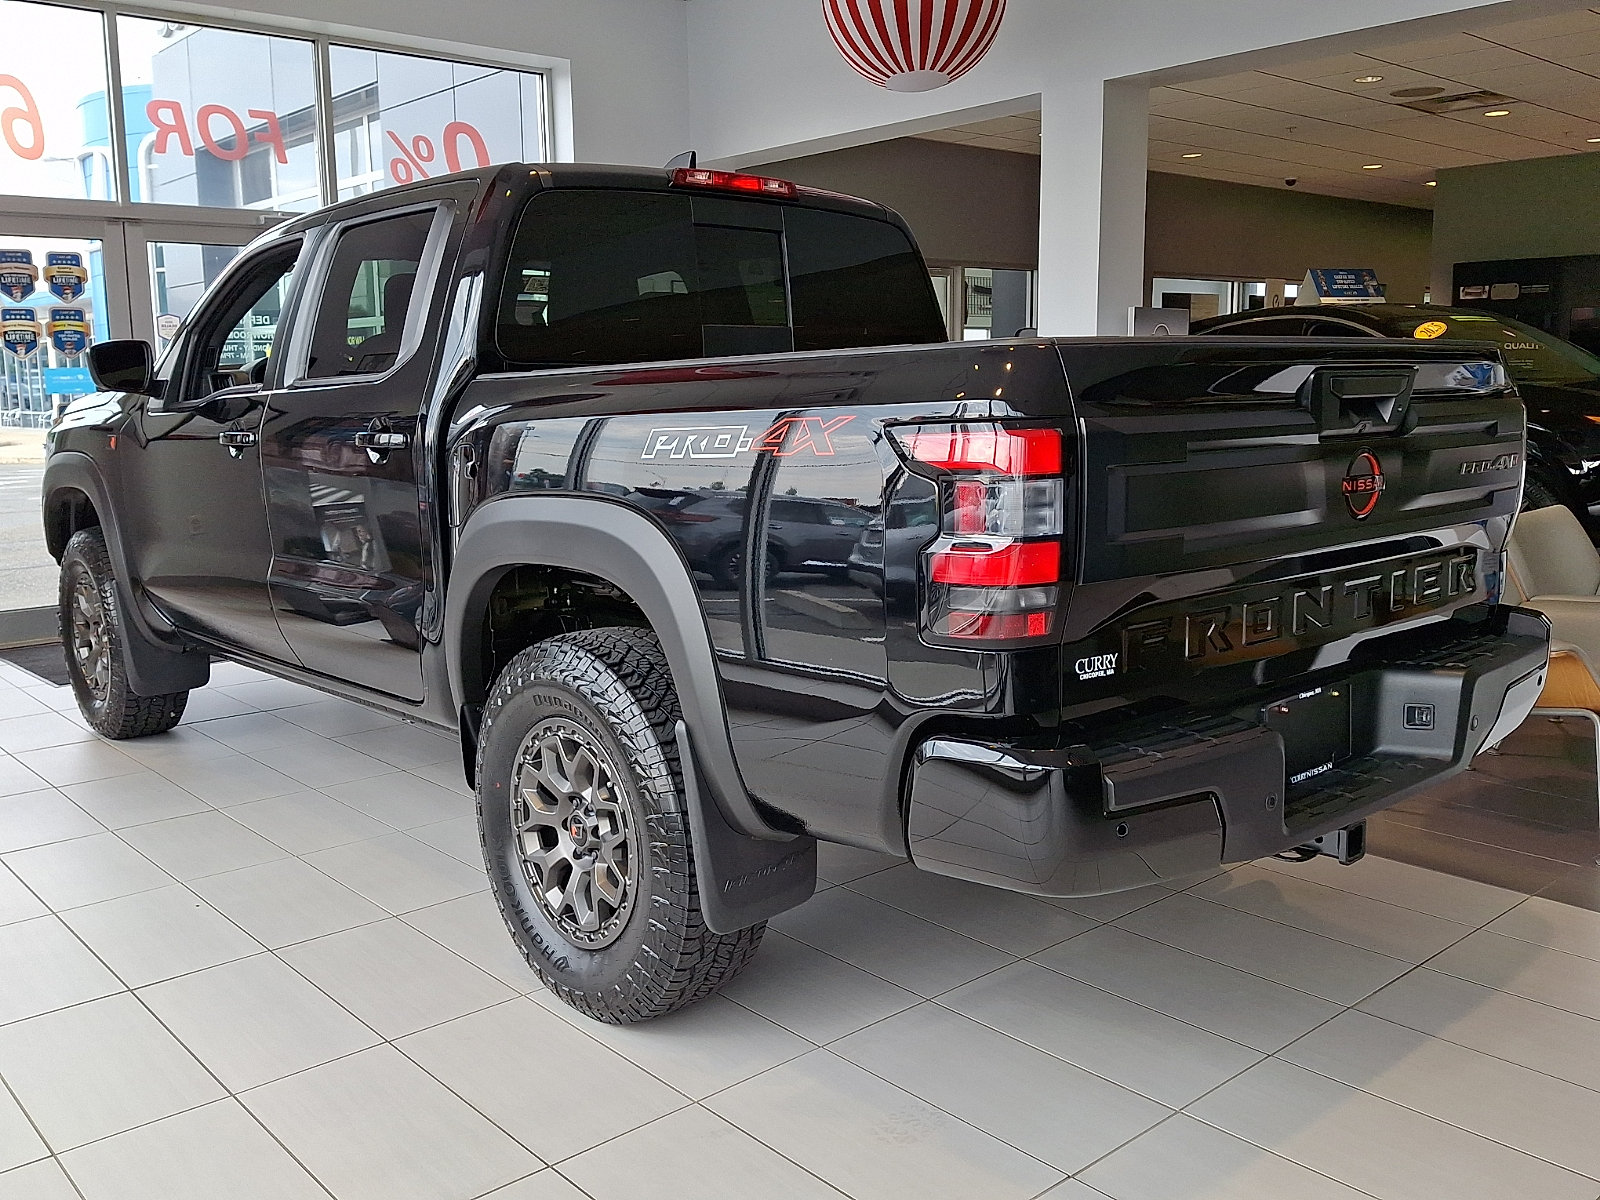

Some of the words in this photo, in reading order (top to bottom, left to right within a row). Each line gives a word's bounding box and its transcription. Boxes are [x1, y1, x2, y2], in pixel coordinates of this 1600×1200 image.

[1342, 476, 1385, 493] NISSAN
[1122, 554, 1477, 674] FRONTIER
[1075, 652, 1118, 674] CURRY
